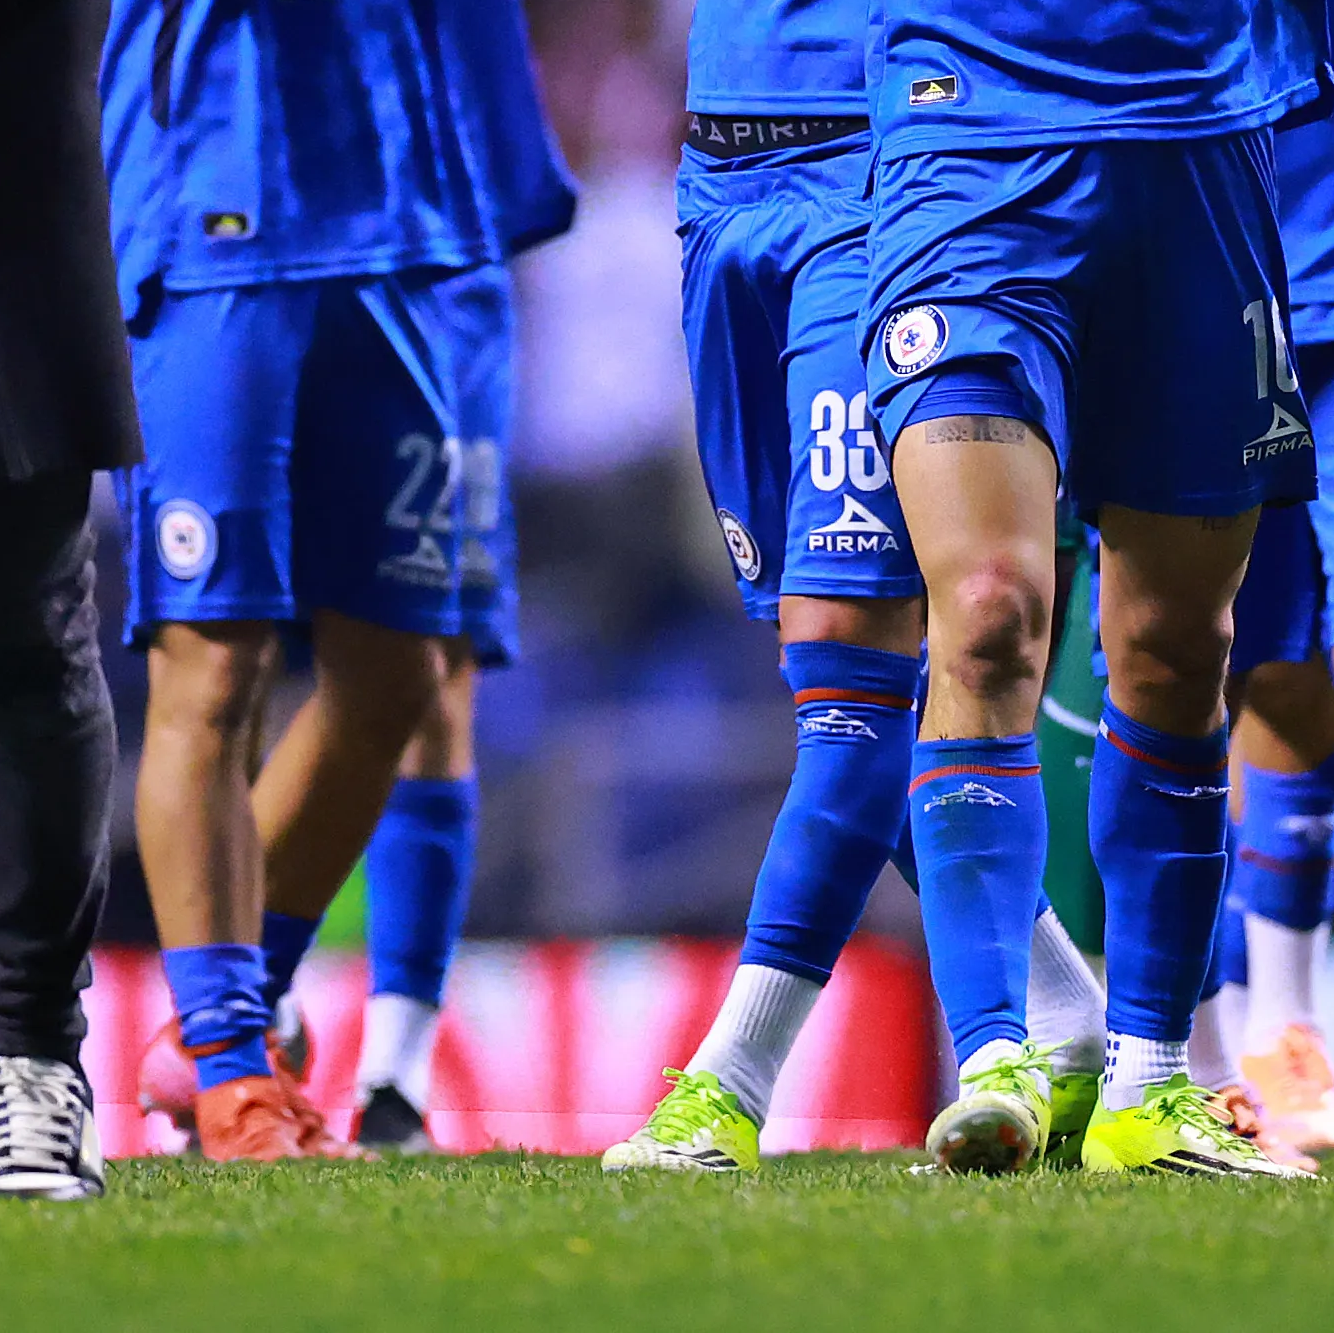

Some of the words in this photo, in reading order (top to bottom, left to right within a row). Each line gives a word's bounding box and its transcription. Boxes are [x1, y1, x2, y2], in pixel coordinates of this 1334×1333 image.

[810, 389, 890, 492] 33
[1242, 433, 1314, 467] PIRMA
[808, 534, 900, 554] PIRMA
